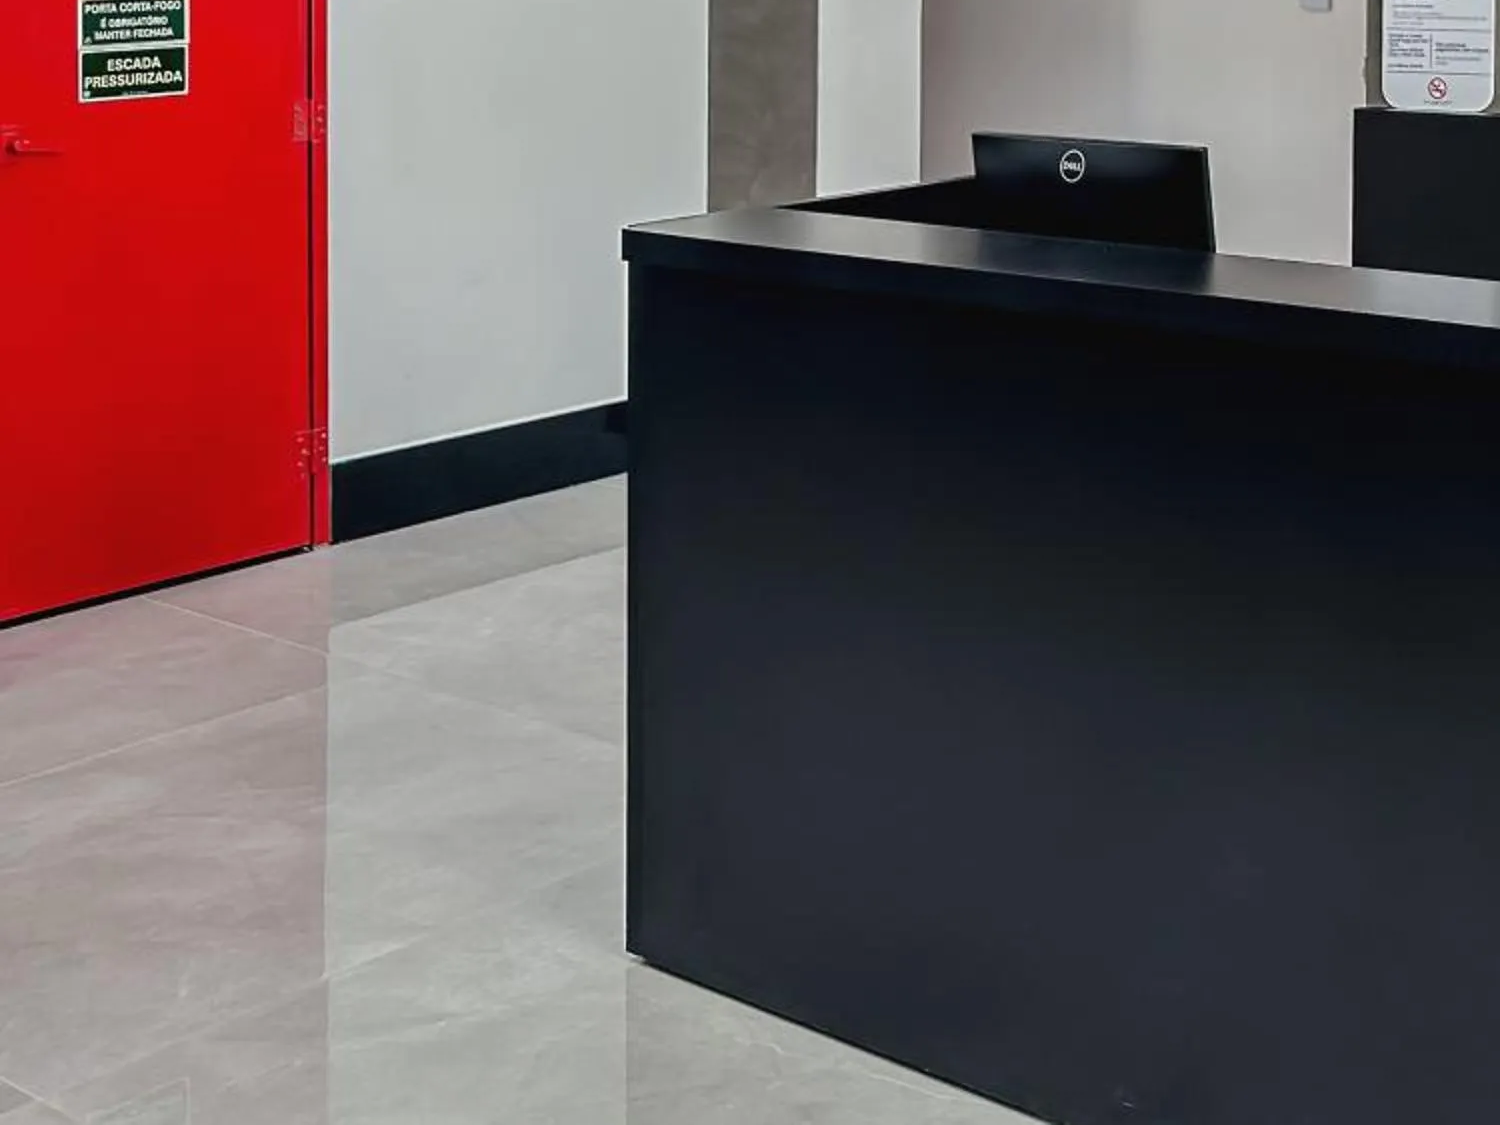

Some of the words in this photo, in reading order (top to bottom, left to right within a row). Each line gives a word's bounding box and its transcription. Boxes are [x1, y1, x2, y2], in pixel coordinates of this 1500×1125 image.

[84, 2, 117, 14] PORTA
[119, 0, 181, 13] CORTA-FOGO
[108, 15, 169, 28] OBRIGATÓRIO
[94, 29, 131, 40] MANTER
[133, 27, 175, 38] FECHADA
[107, 56, 162, 72] ESCADA
[84, 70, 183, 89] PRESSURIZADA
